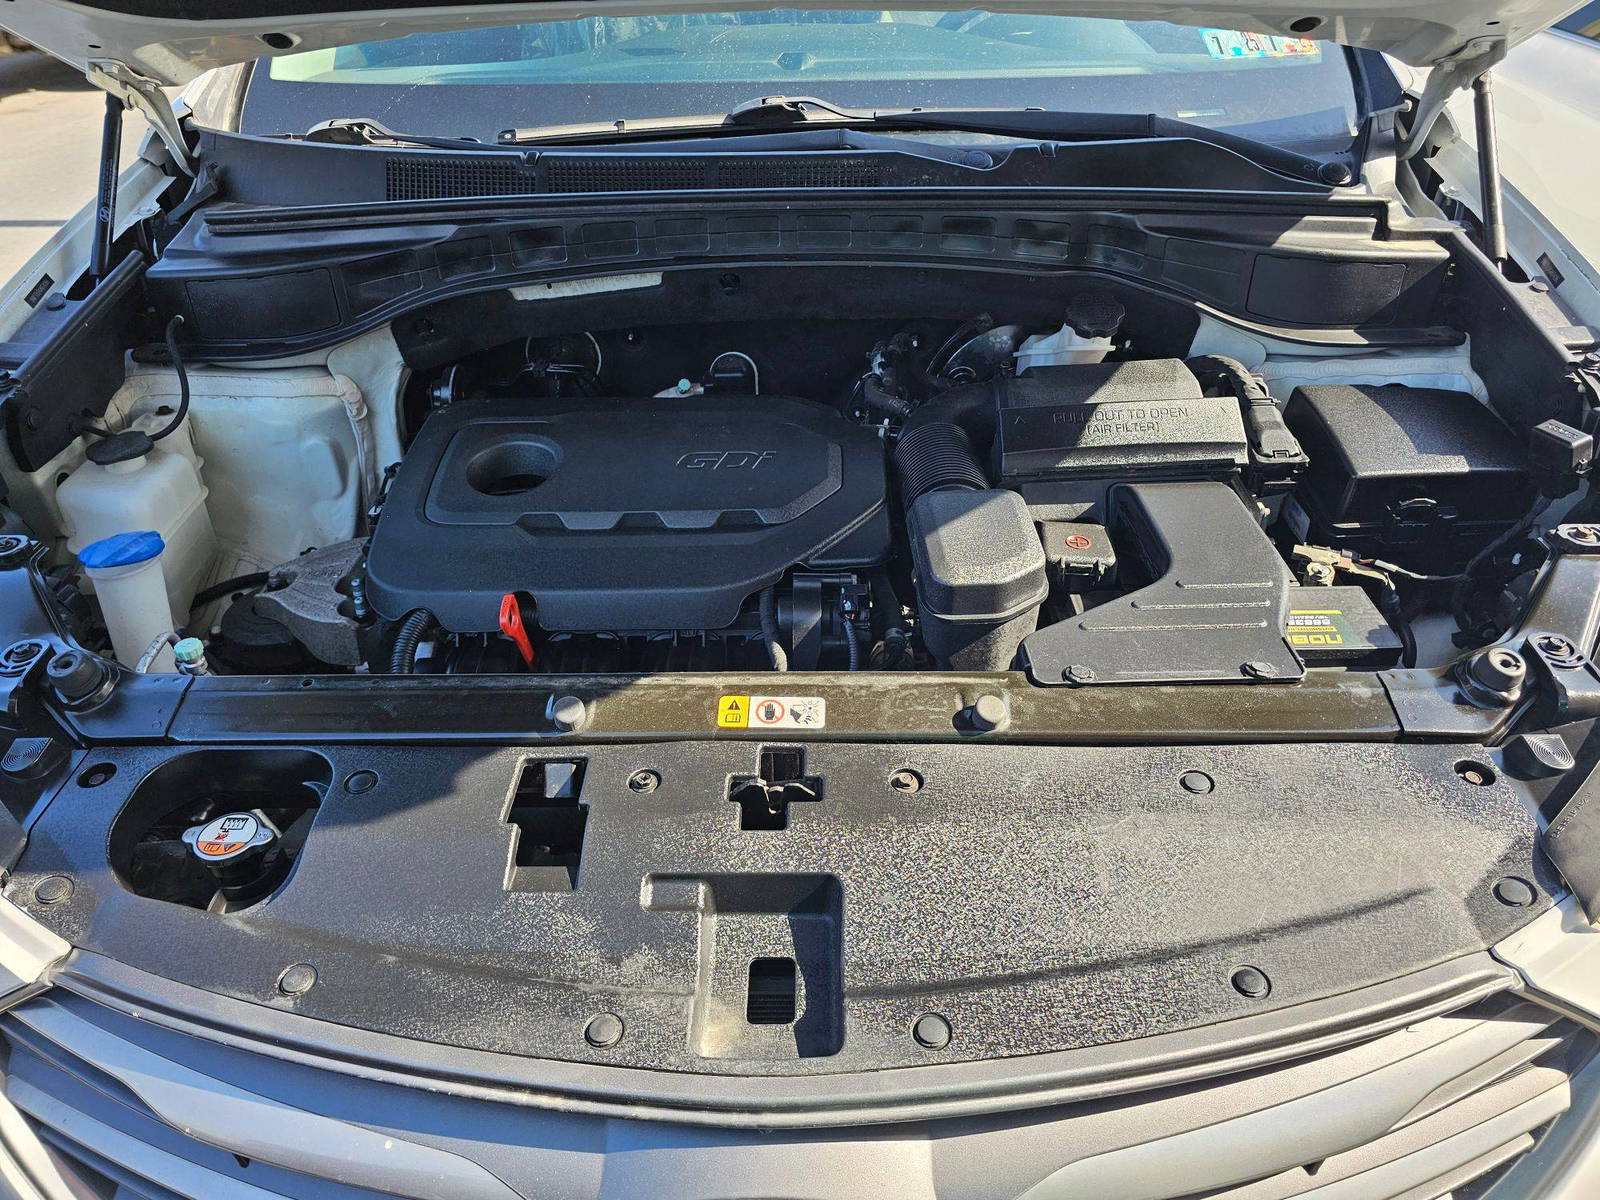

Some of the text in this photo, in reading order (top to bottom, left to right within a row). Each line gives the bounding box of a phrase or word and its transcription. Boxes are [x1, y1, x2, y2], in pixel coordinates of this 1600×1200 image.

[1052, 407, 1189, 425] PULL OUT TO OPEN
[1086, 421, 1160, 435] (AIR FILTER)
